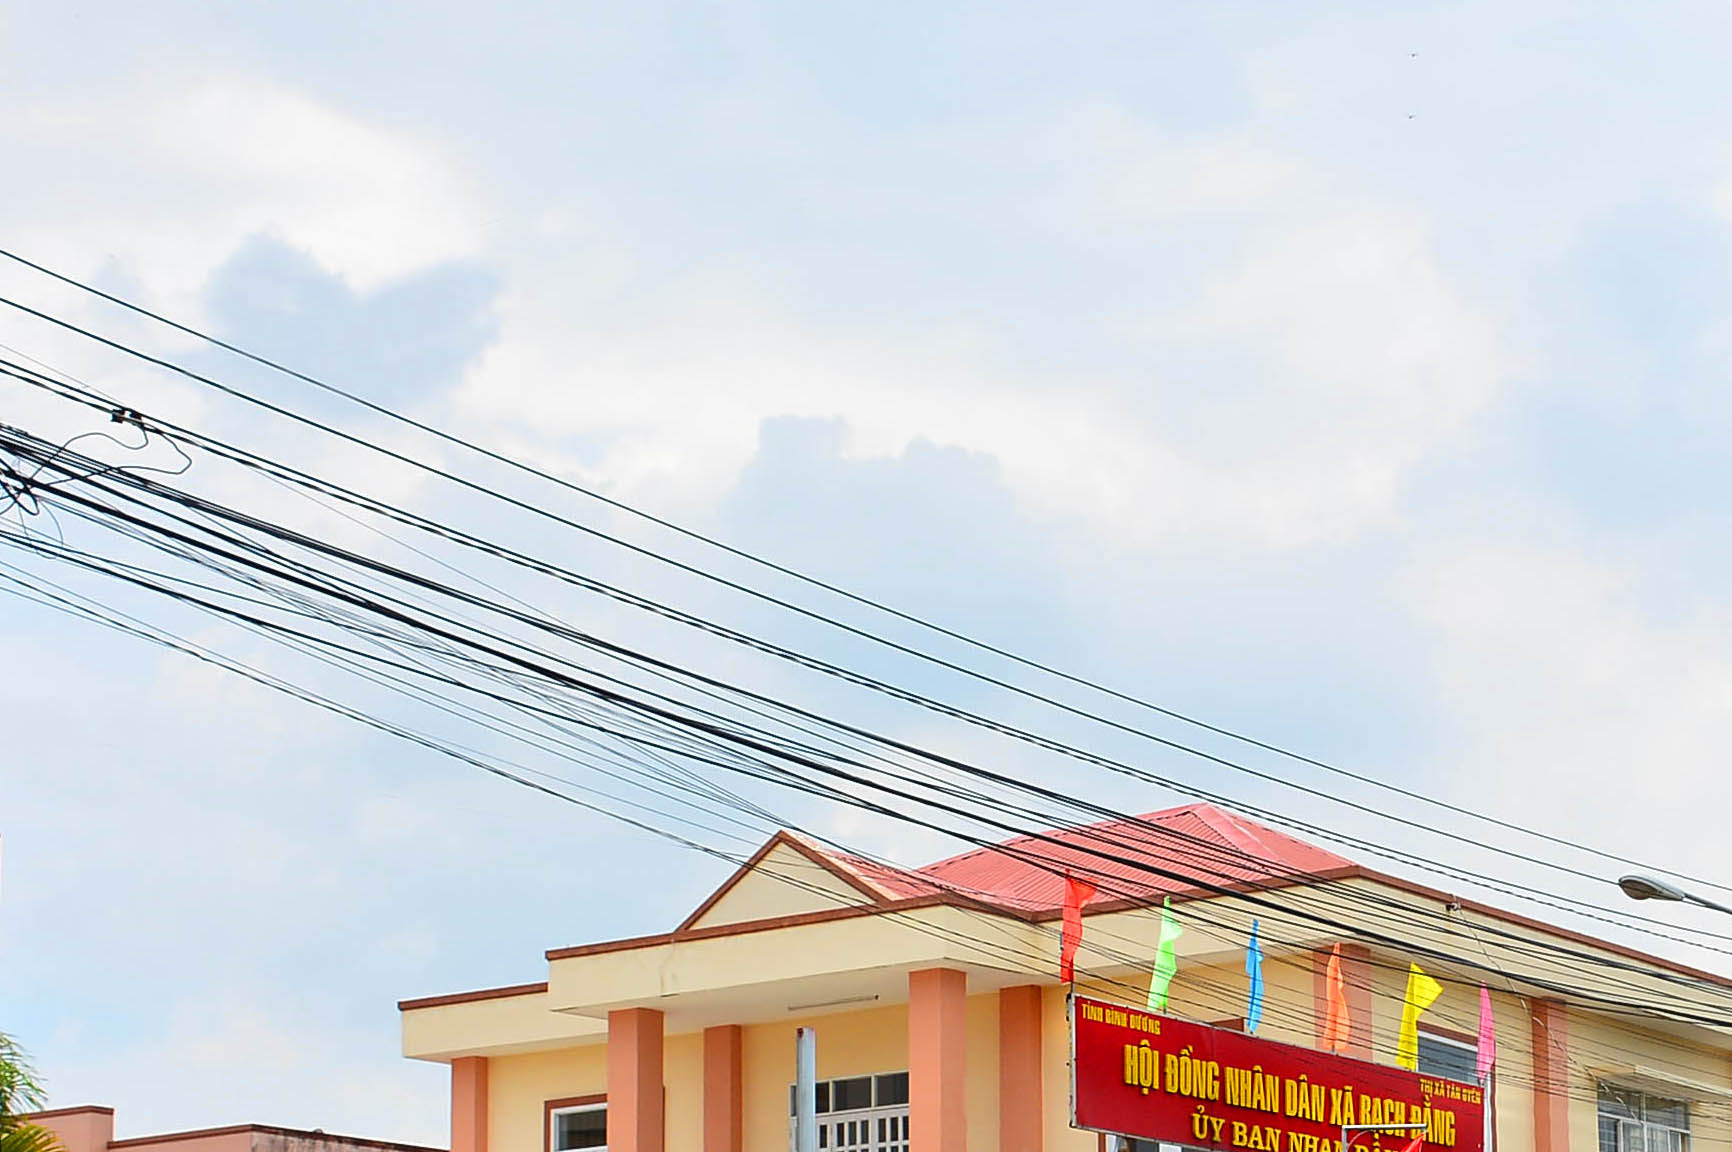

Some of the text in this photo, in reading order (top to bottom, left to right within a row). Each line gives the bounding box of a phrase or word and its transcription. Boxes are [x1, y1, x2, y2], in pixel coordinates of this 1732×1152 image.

[1081, 1000, 1161, 1035] TỈNH BÌNH DƯƠNG
[1124, 1039, 1457, 1147] HỘI ĐỒNG NHÂN DÂN XÃ BẠCH ĐẰNG
[1191, 1105, 1225, 1142] ỦY
[1232, 1121, 1281, 1152] BAN
